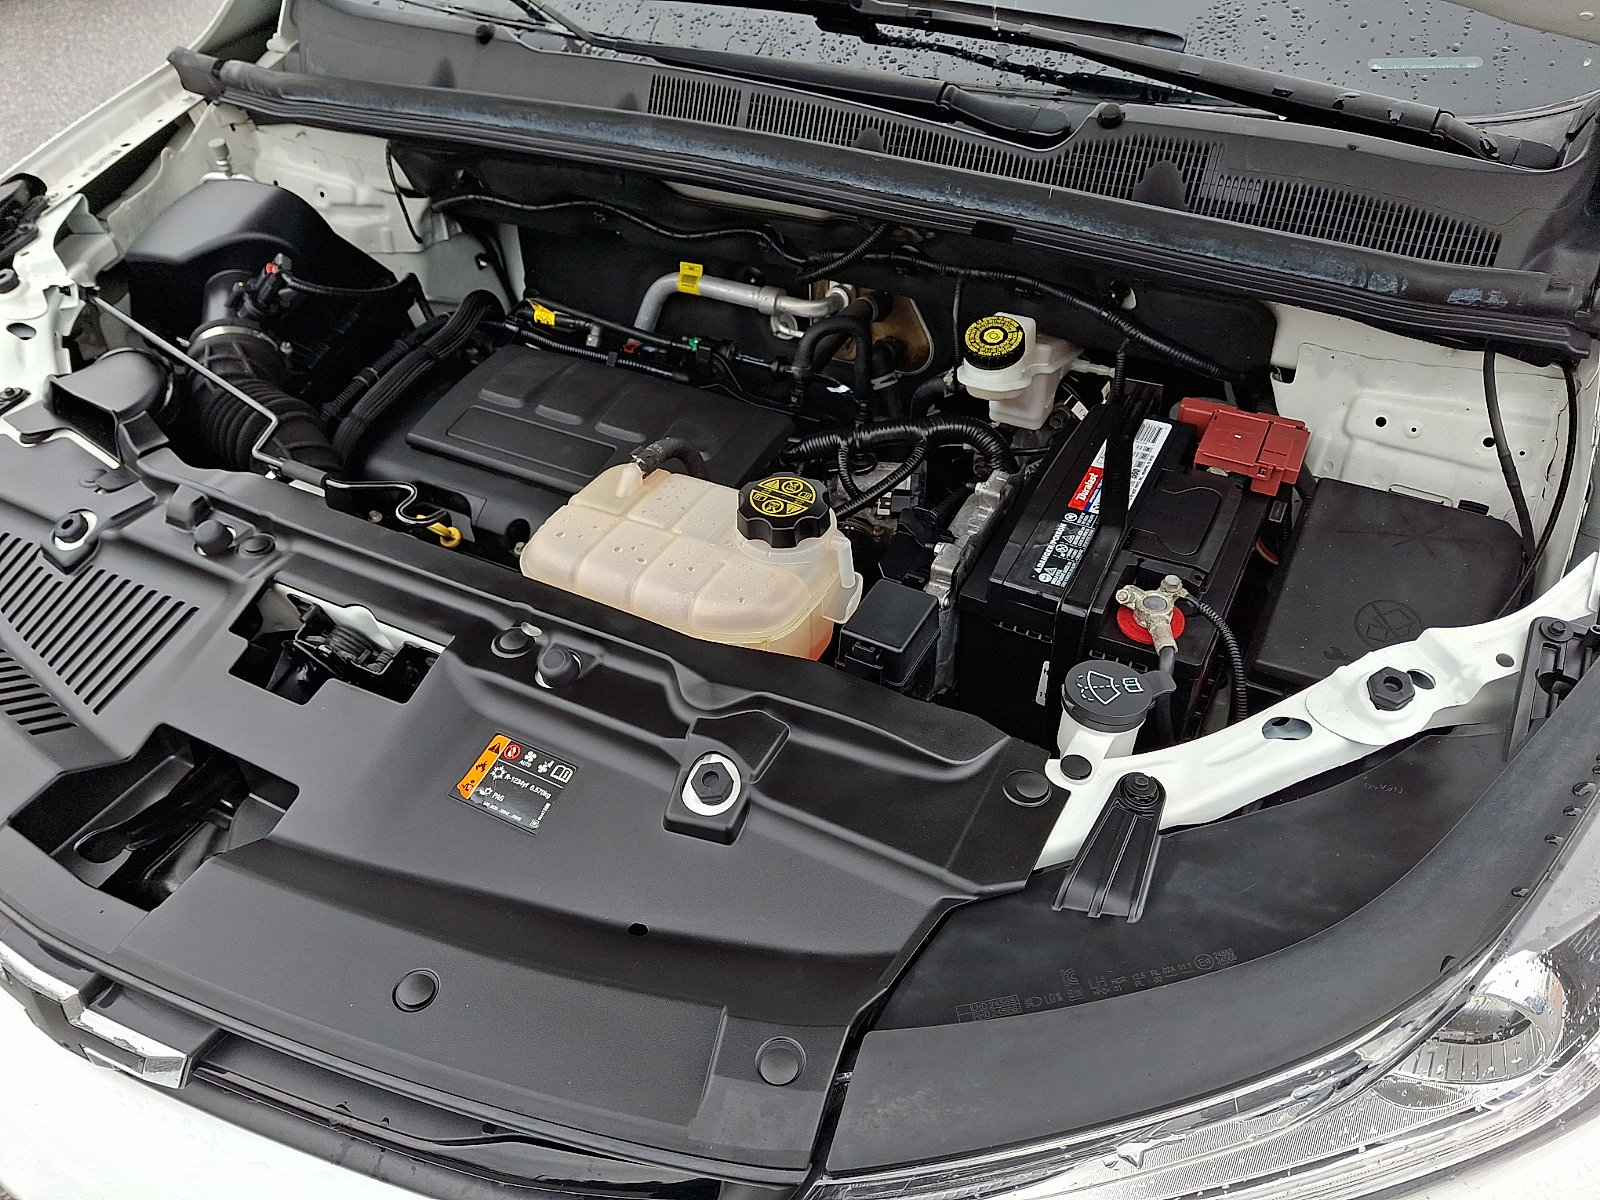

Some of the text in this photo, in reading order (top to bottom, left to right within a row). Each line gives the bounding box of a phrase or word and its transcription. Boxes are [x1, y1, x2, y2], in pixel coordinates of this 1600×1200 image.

[1075, 472, 1098, 501] Duralast
[519, 760, 532, 768] AUTO
[504, 774, 551, 799] R-1234yf 0.570kg
[492, 792, 505, 802] PAG
